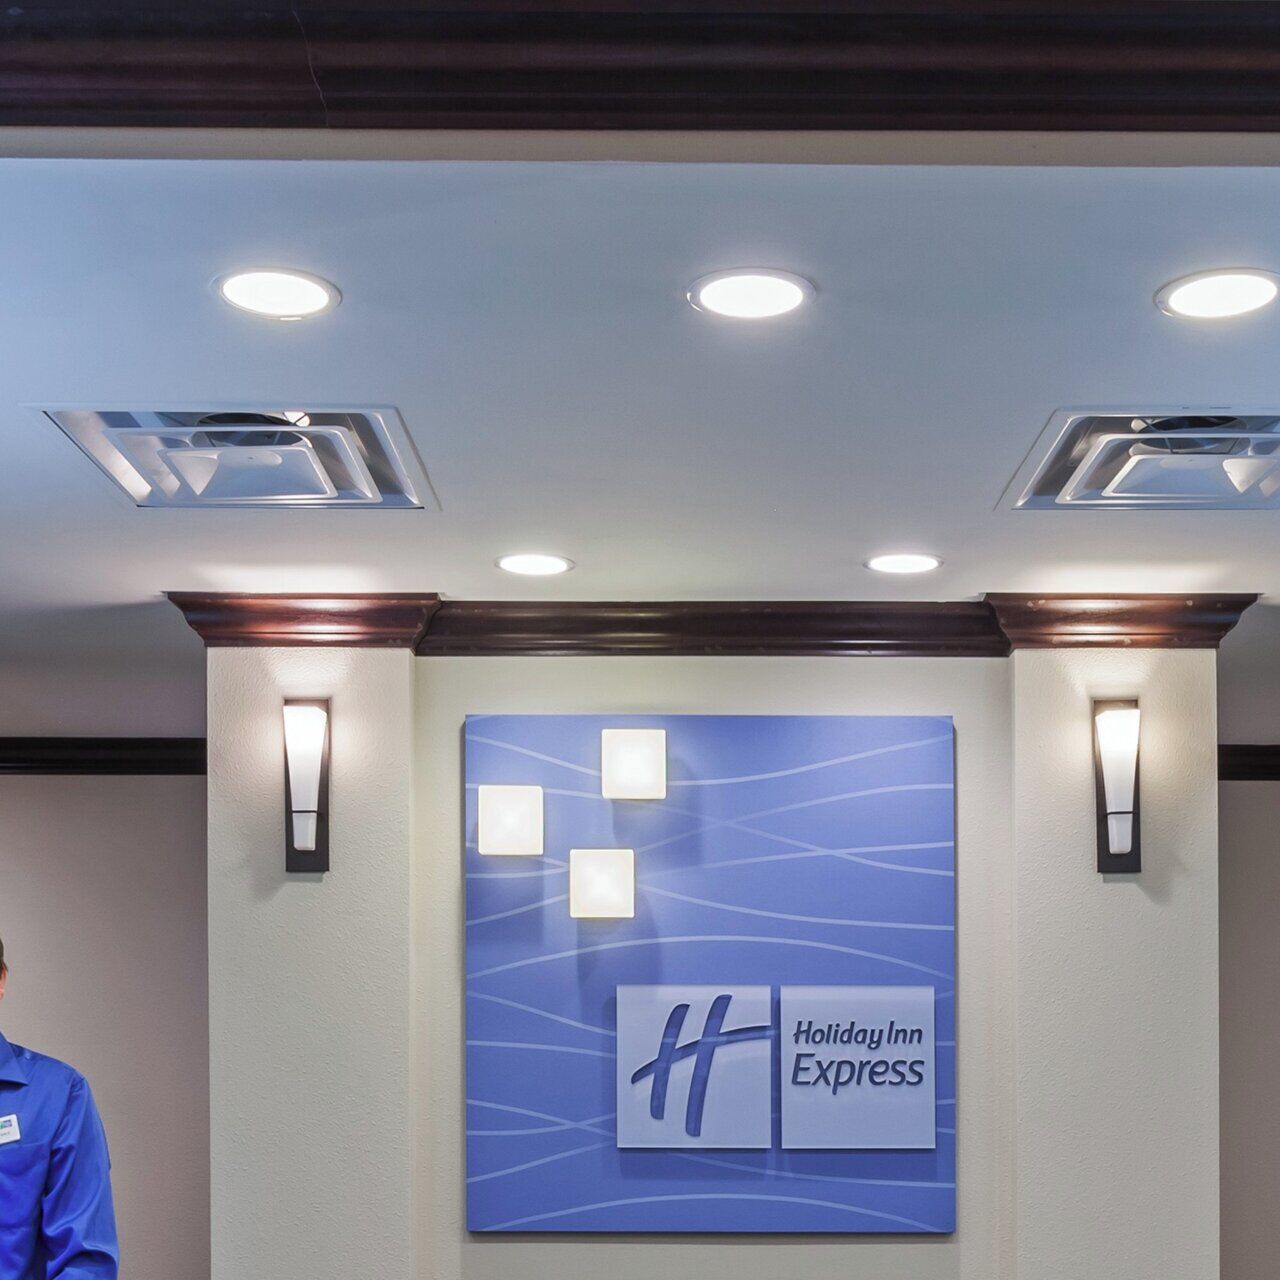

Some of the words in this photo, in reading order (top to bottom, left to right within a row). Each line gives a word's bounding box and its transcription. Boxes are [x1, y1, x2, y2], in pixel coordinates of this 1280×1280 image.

[793, 1020, 884, 1050] Holiday
[887, 1020, 923, 1044] Inn
[791, 1053, 925, 1095] Express
